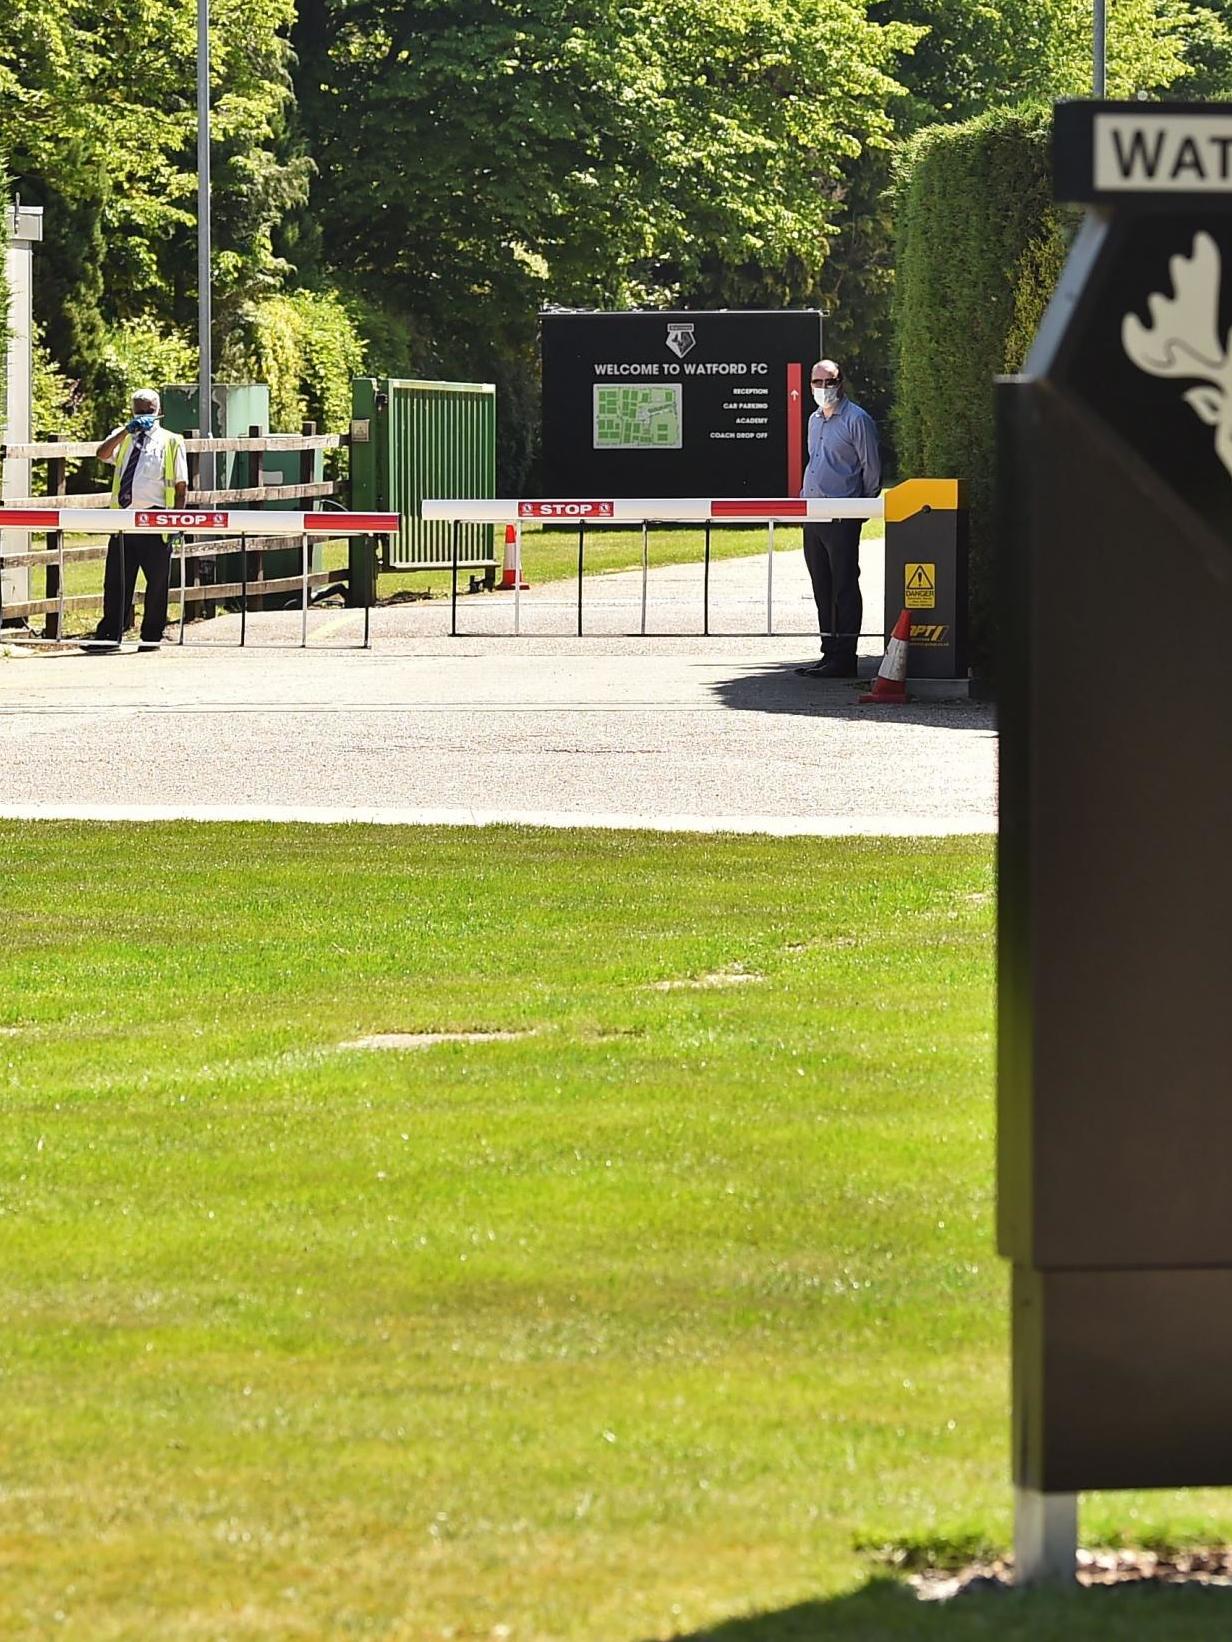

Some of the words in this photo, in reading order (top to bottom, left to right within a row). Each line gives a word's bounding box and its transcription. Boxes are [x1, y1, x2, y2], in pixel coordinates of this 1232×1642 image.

[594, 363, 660, 375] WELCOME
[662, 363, 681, 375] TO
[683, 363, 748, 375] WATFORD
[751, 363, 769, 375] FC
[540, 504, 593, 515] STOP
[156, 514, 207, 526] STOP
